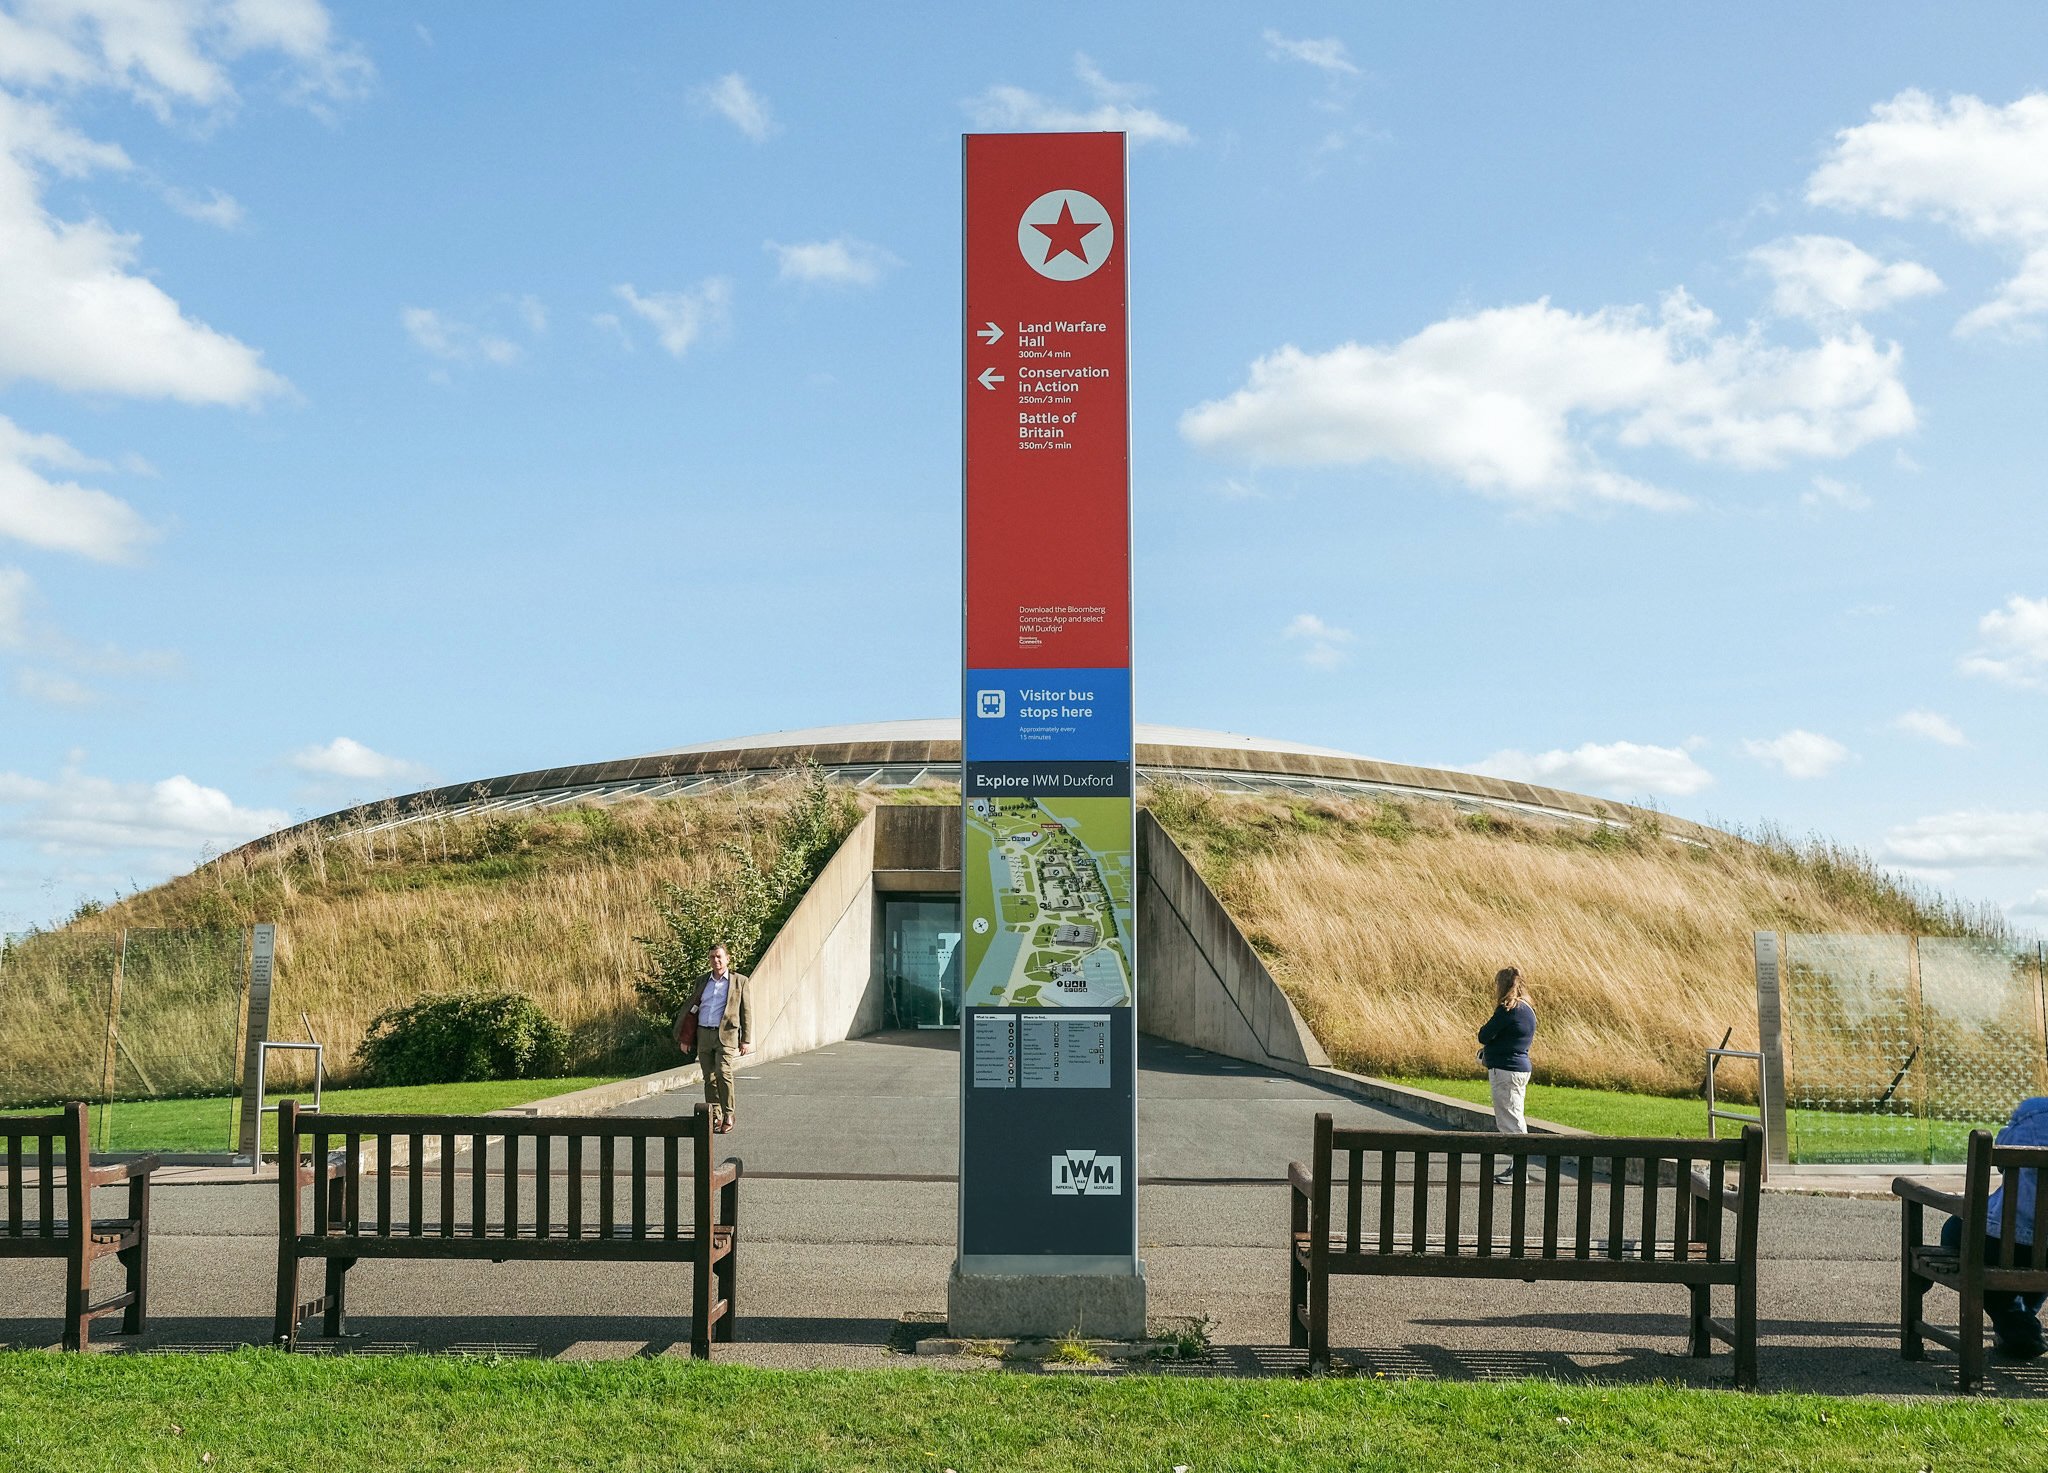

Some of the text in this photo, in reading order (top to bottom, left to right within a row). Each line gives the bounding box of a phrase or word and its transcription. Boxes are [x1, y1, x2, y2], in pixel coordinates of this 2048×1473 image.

[1019, 321, 1107, 333] Land Warfare
[1019, 336, 1045, 347] Hall
[1018, 350, 1071, 358] 300m/4 min
[1019, 367, 1109, 378] Conservation
[1019, 381, 1079, 392] in Action
[1018, 396, 1072, 404] 250m/3 min
[1019, 412, 1077, 424] Battle of
[1019, 427, 1064, 438] Britain
[1018, 441, 1072, 449] 350m/5 min
[1067, 606, 1106, 614] Bloomberg
[1053, 616, 1067, 624] App
[1019, 689, 1094, 701] Visitor bus
[1019, 706, 1093, 720] stops here
[976, 774, 1114, 789] Explore IWM Duxford
[1061, 1160, 1114, 1183] IWM
